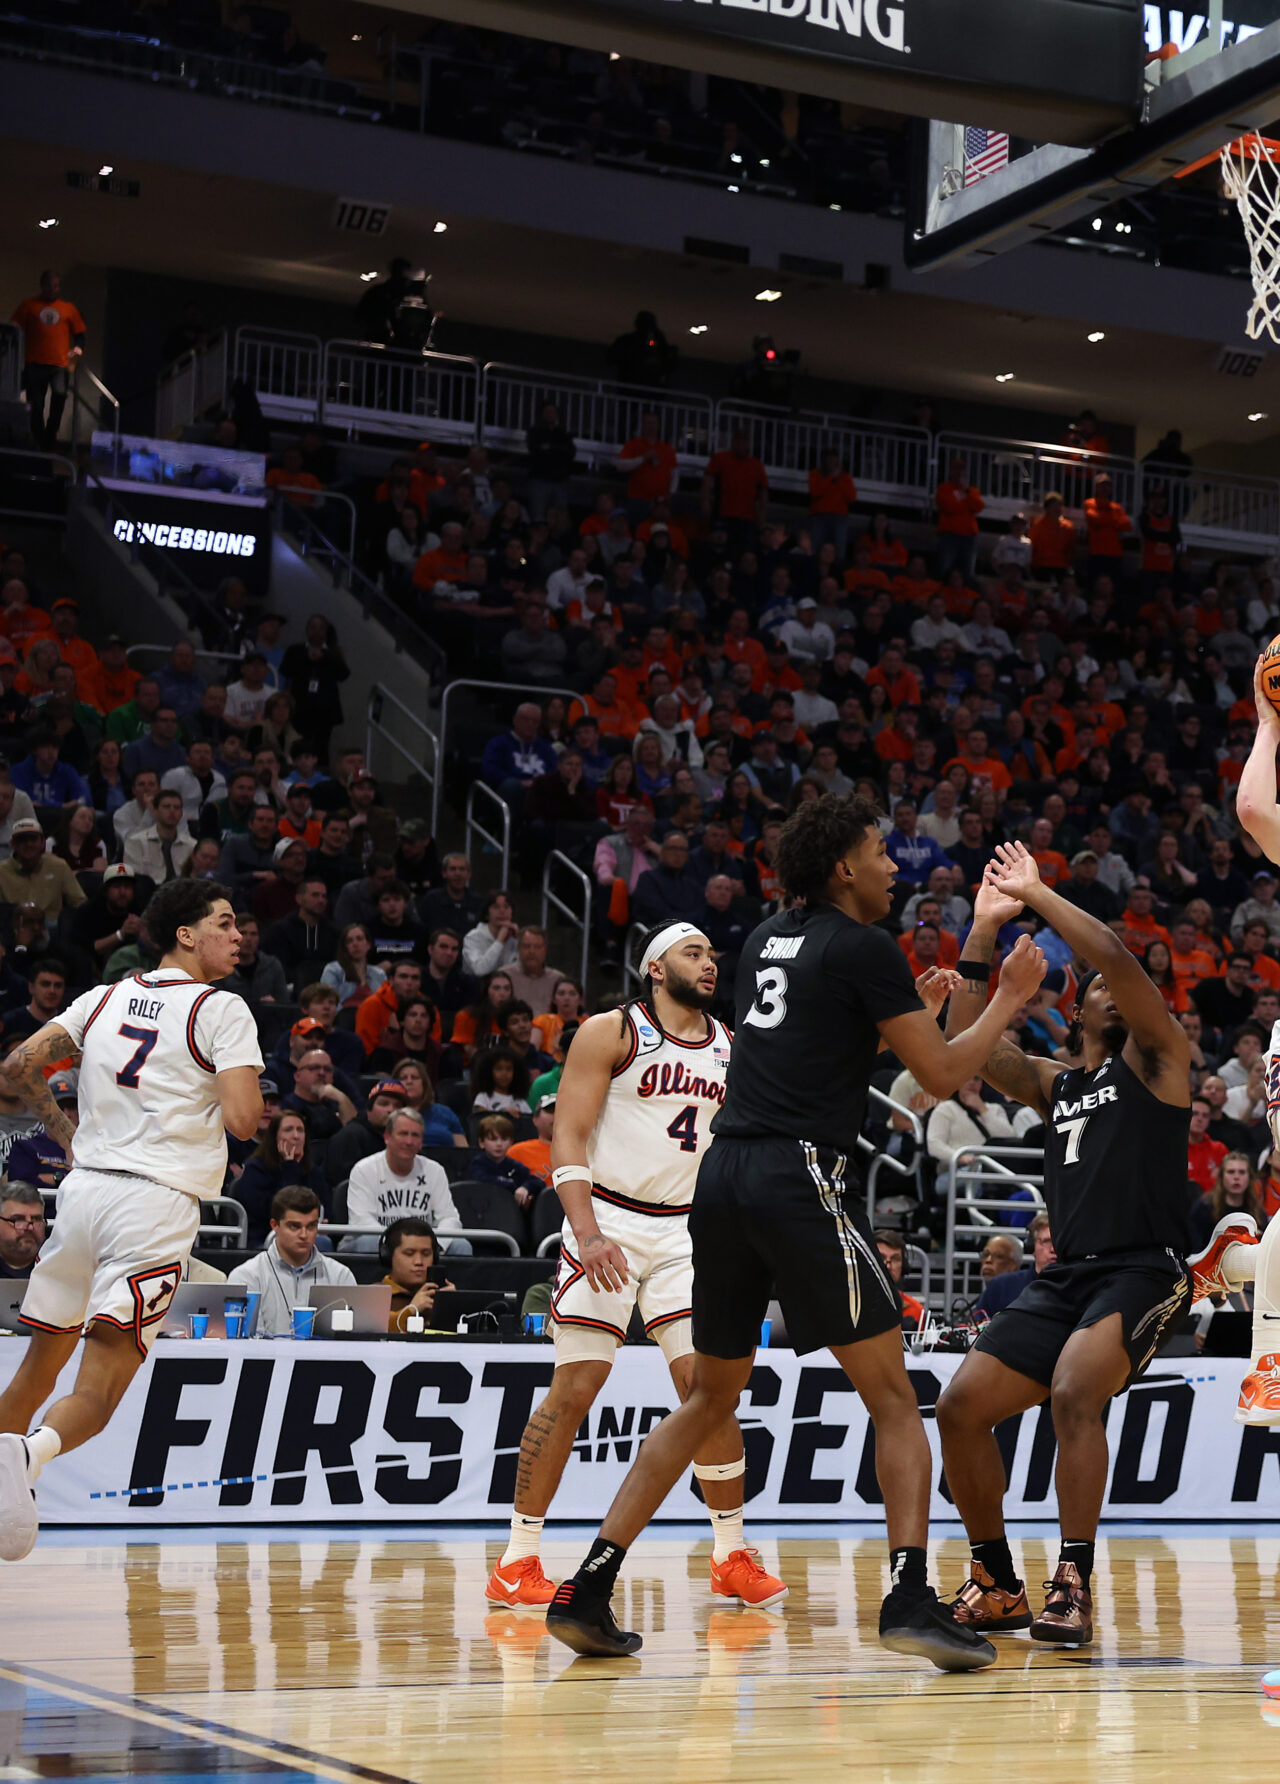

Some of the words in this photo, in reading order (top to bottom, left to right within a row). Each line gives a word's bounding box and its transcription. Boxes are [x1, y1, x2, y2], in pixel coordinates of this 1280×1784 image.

[337, 203, 388, 233] 106
[1220, 351, 1262, 377] 106
[760, 936, 806, 959] SWAIN
[128, 998, 165, 1021] RILEY
[743, 966, 788, 1030] 3
[116, 1022, 160, 1090] 7
[637, 1062, 728, 1106] Illinoi
[667, 1104, 699, 1153] 4
[1054, 1116, 1090, 1165] 7
[378, 1189, 431, 1213] XAVIER
[128, 1358, 554, 1507] FIRST
